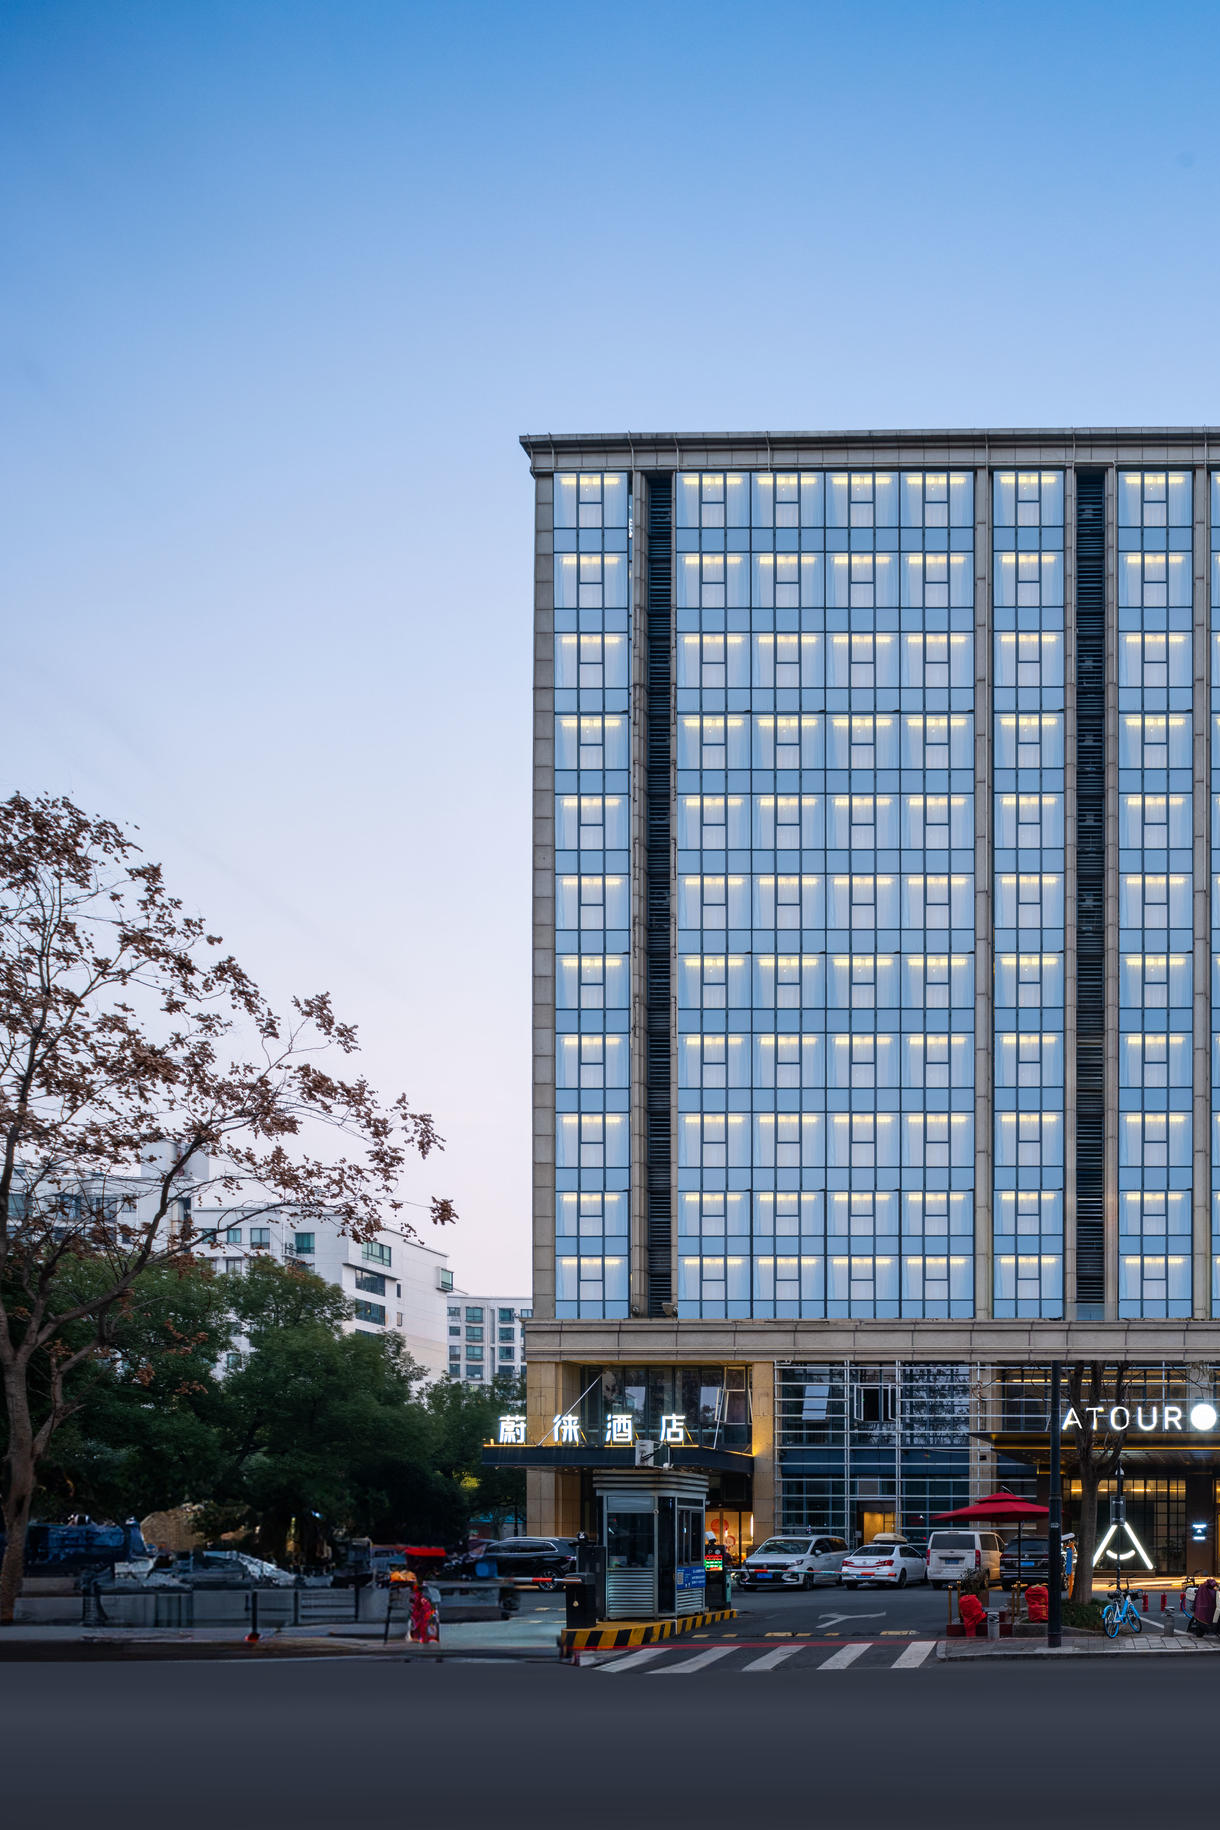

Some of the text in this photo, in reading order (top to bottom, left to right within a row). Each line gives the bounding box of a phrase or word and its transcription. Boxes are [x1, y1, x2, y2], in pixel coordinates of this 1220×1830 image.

[498, 1413, 687, 1444] 蔚徕酒店
[1061, 1405, 1183, 1431] ATOUR
